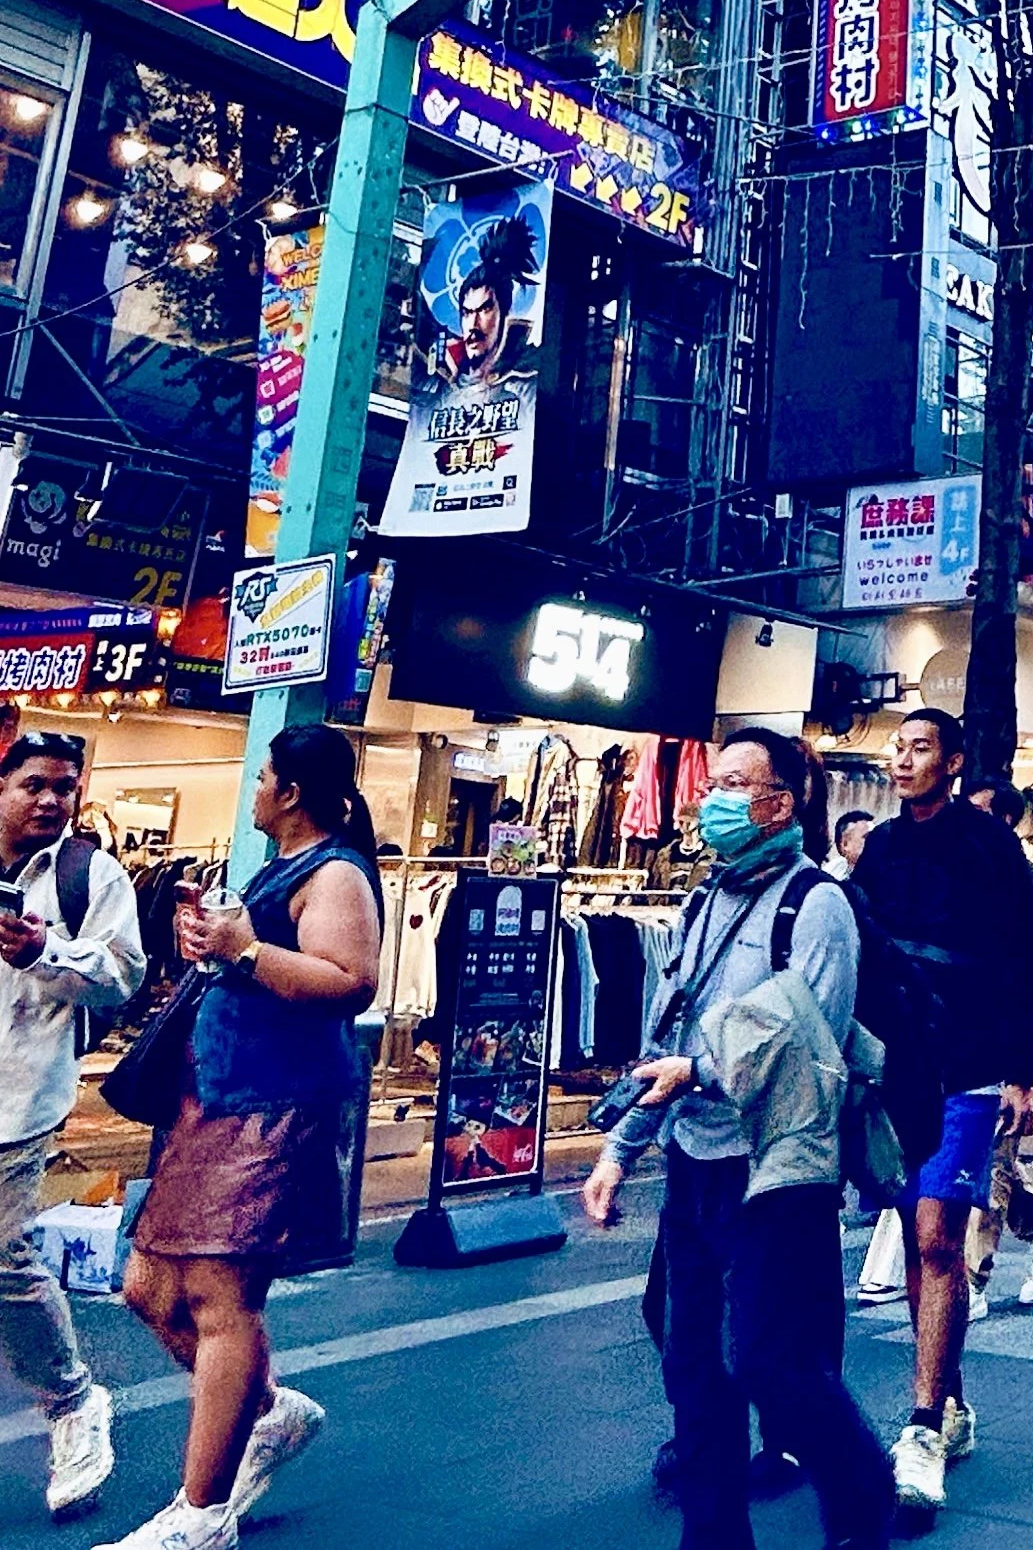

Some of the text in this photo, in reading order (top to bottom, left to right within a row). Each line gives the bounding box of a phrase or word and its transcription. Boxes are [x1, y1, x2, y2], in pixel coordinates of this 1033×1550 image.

[646, 182, 690, 234] 2F
[429, 400, 520, 438] 信長之野望
[446, 438, 497, 474] 真戰
[6, 539, 62, 568] magi
[131, 567, 183, 605] 2F
[860, 572, 928, 586] welcome
[105, 643, 147, 682] 3F
